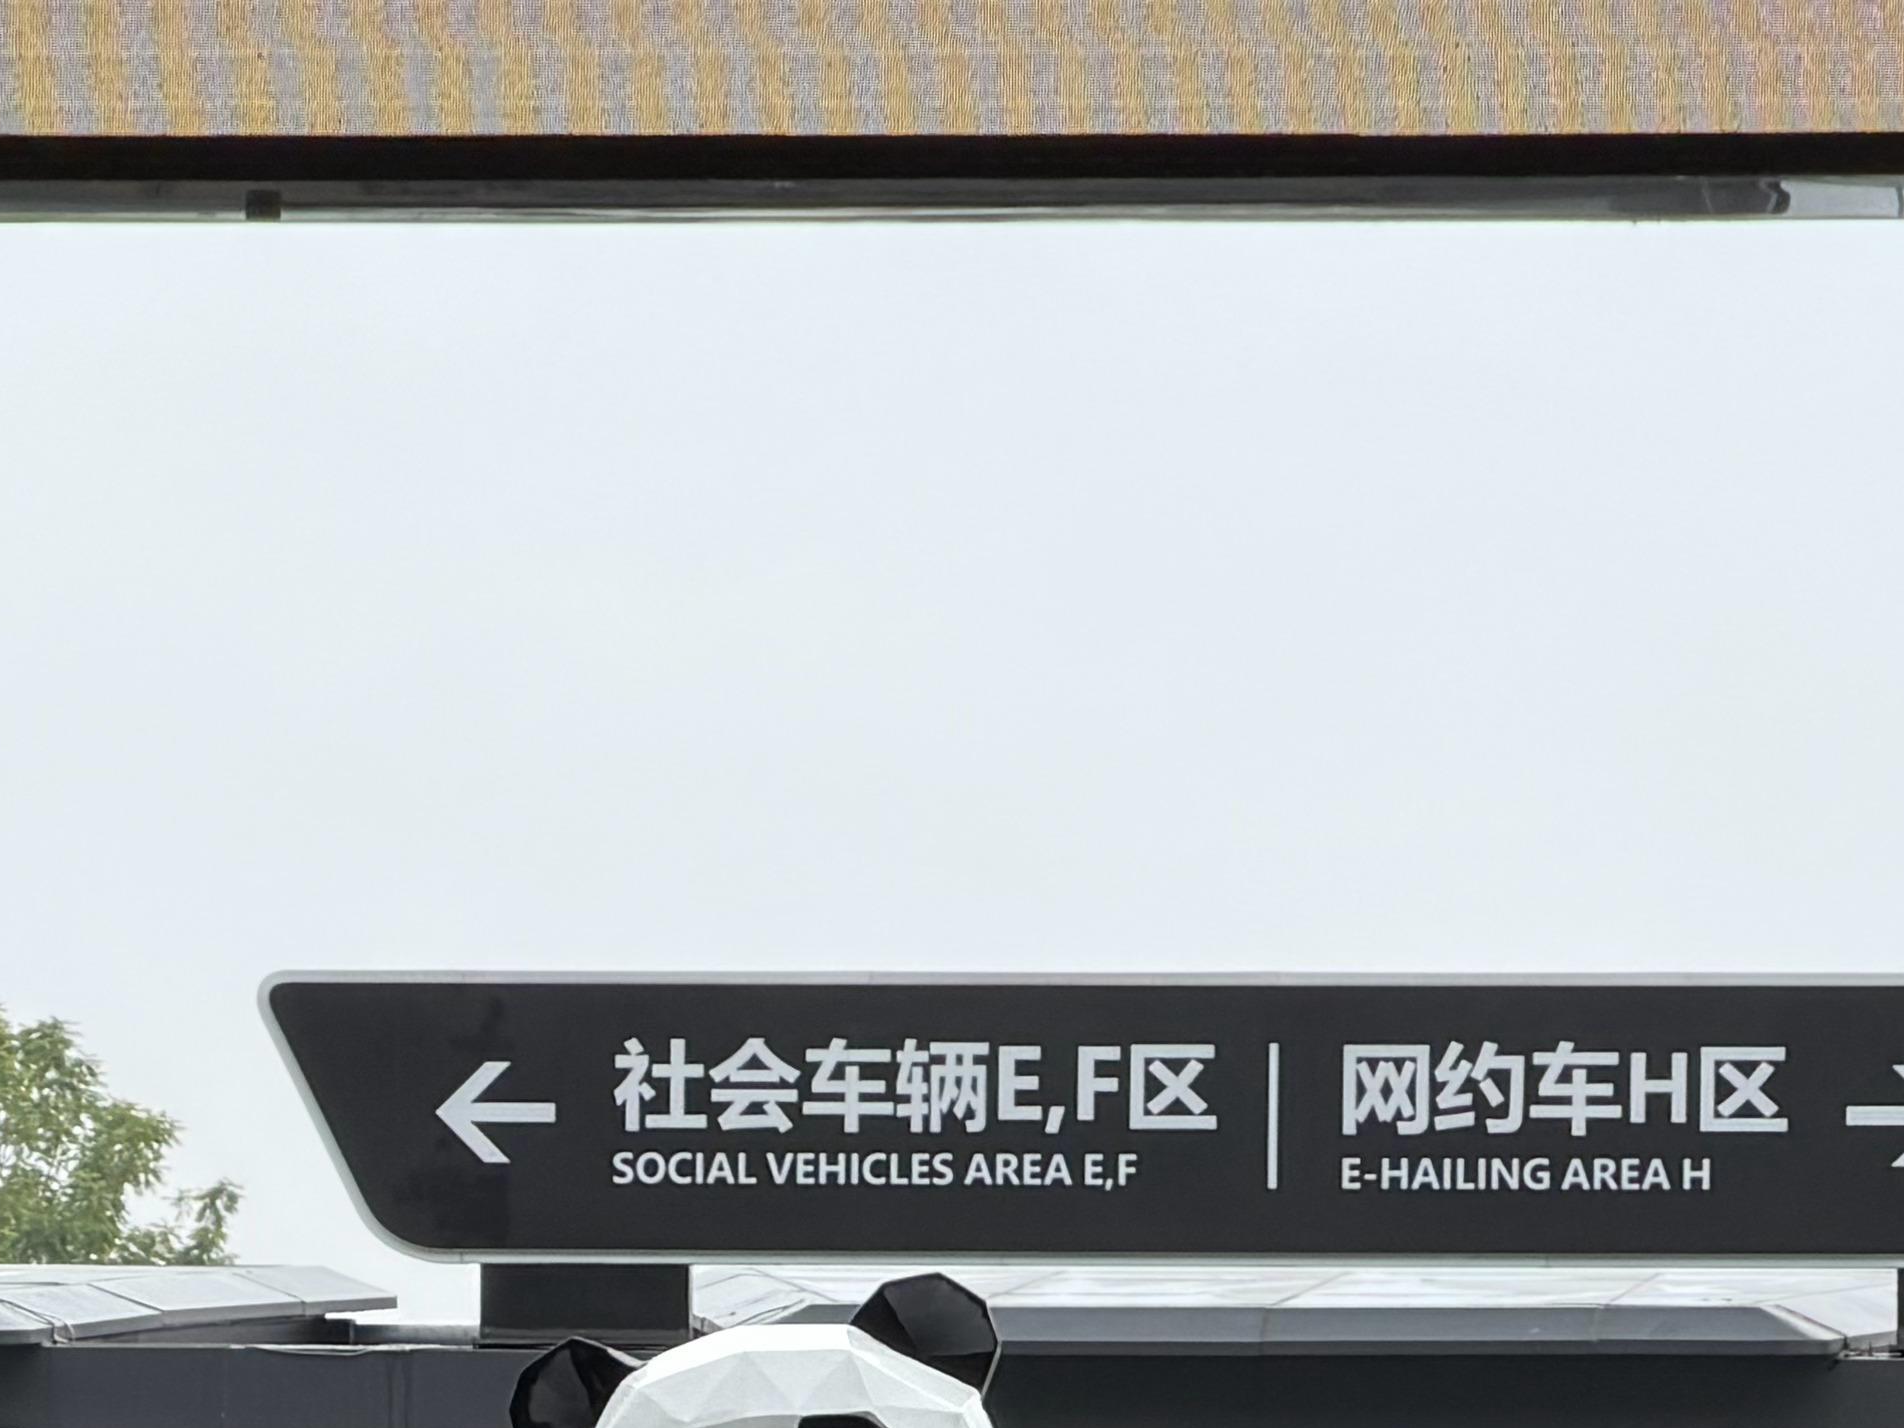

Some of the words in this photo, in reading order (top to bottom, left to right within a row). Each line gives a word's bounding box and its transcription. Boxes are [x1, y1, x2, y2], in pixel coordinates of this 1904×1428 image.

[613, 1037, 1218, 1134] 社会车辆E,F区
[1342, 1040, 1789, 1137] 网约车H区
[612, 1151, 757, 1186] SOCIAL
[766, 1151, 954, 1186] VEHICLES
[963, 1152, 1074, 1186] AREA
[1084, 1152, 1139, 1191] E,F
[1341, 1157, 1551, 1191] E-HAILING
[1561, 1157, 1672, 1191] AREA
[1682, 1157, 1711, 1191] H
